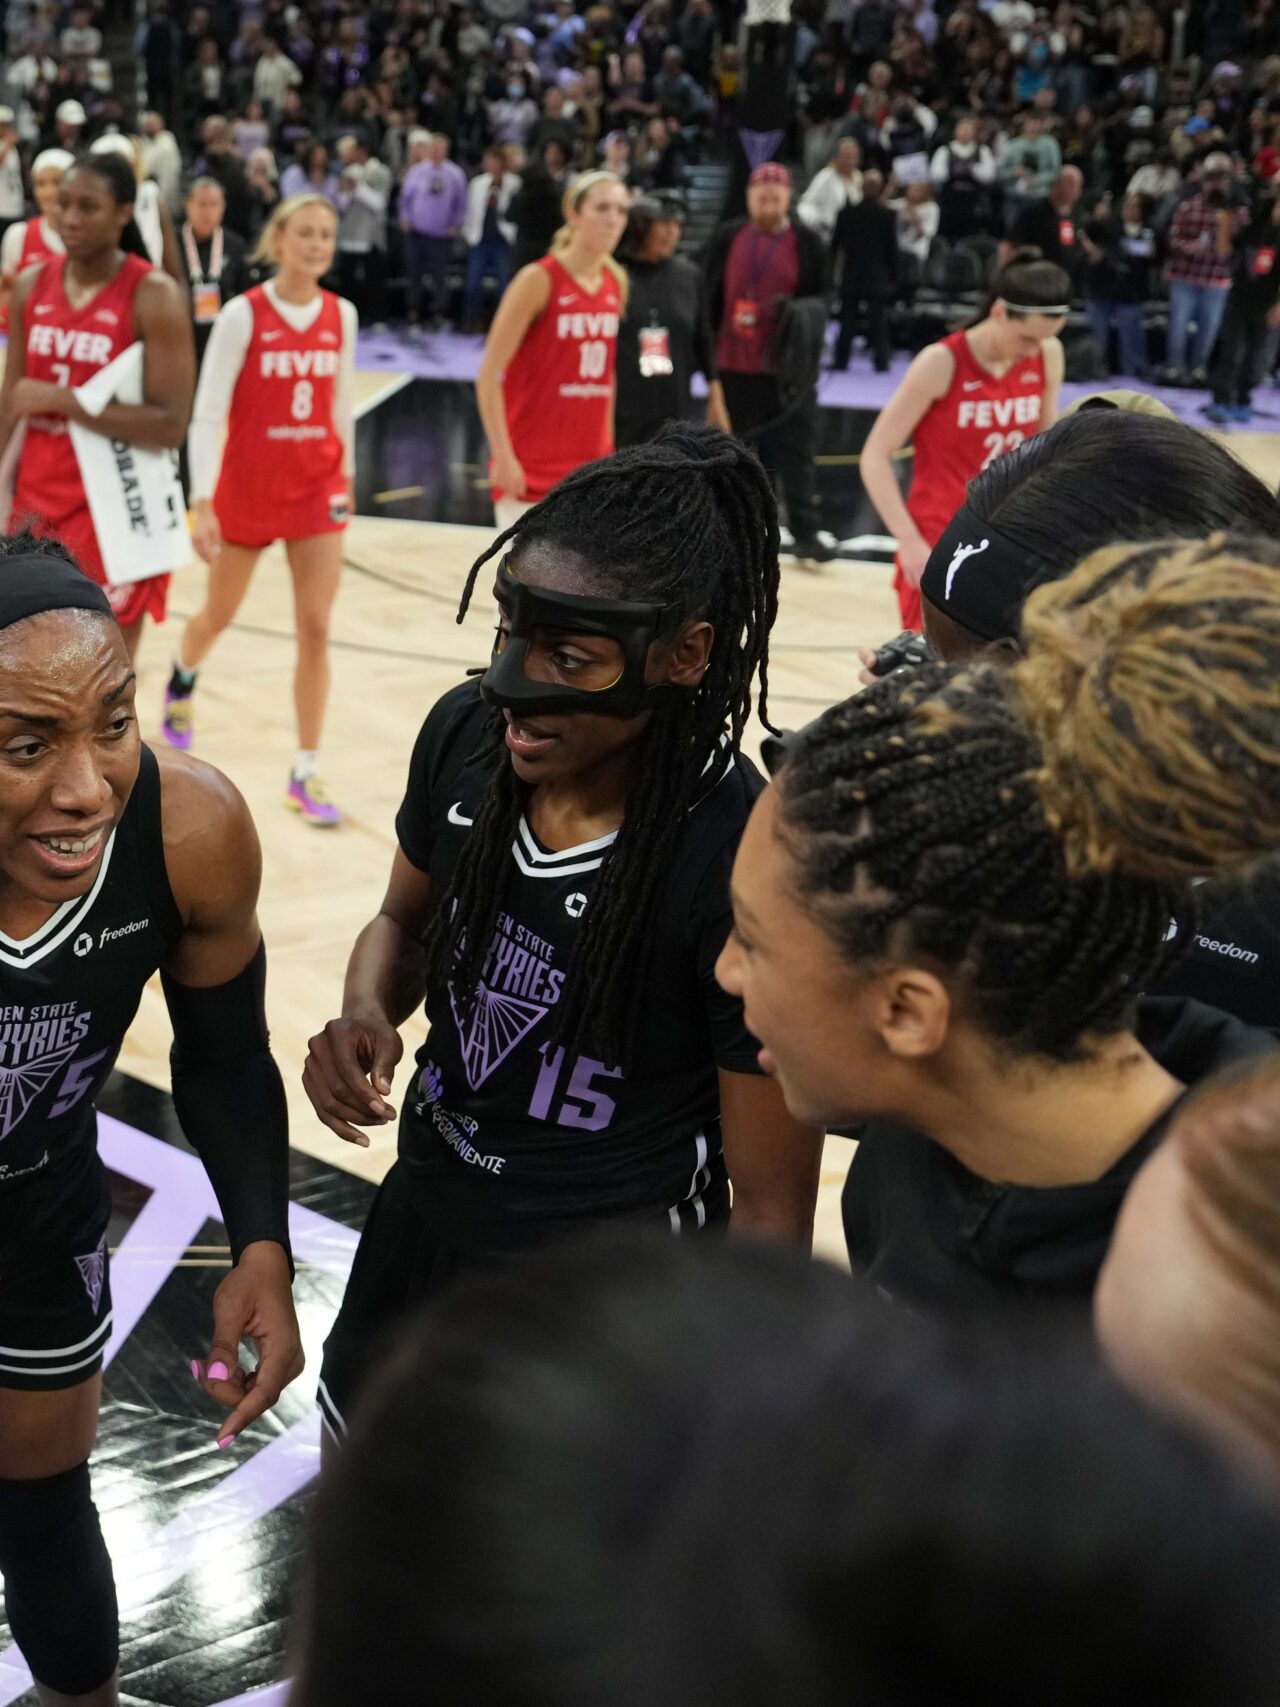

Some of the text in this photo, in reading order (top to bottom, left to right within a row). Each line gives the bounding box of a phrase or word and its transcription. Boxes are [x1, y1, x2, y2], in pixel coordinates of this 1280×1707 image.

[27, 324, 112, 364] FEVER
[579, 341, 607, 378] 10
[291, 380, 314, 420] 8
[110, 438, 148, 533] ORADE
[99, 918, 149, 949] freedom
[516, 925, 555, 961] STATE
[1193, 934, 1259, 964] reedom
[482, 932, 566, 1005] YRIES
[30, 1001, 78, 1021] STATE
[47, 1047, 109, 1120] 5
[528, 1039, 625, 1132] 15
[432, 1112, 506, 1175] PERMANENTE
